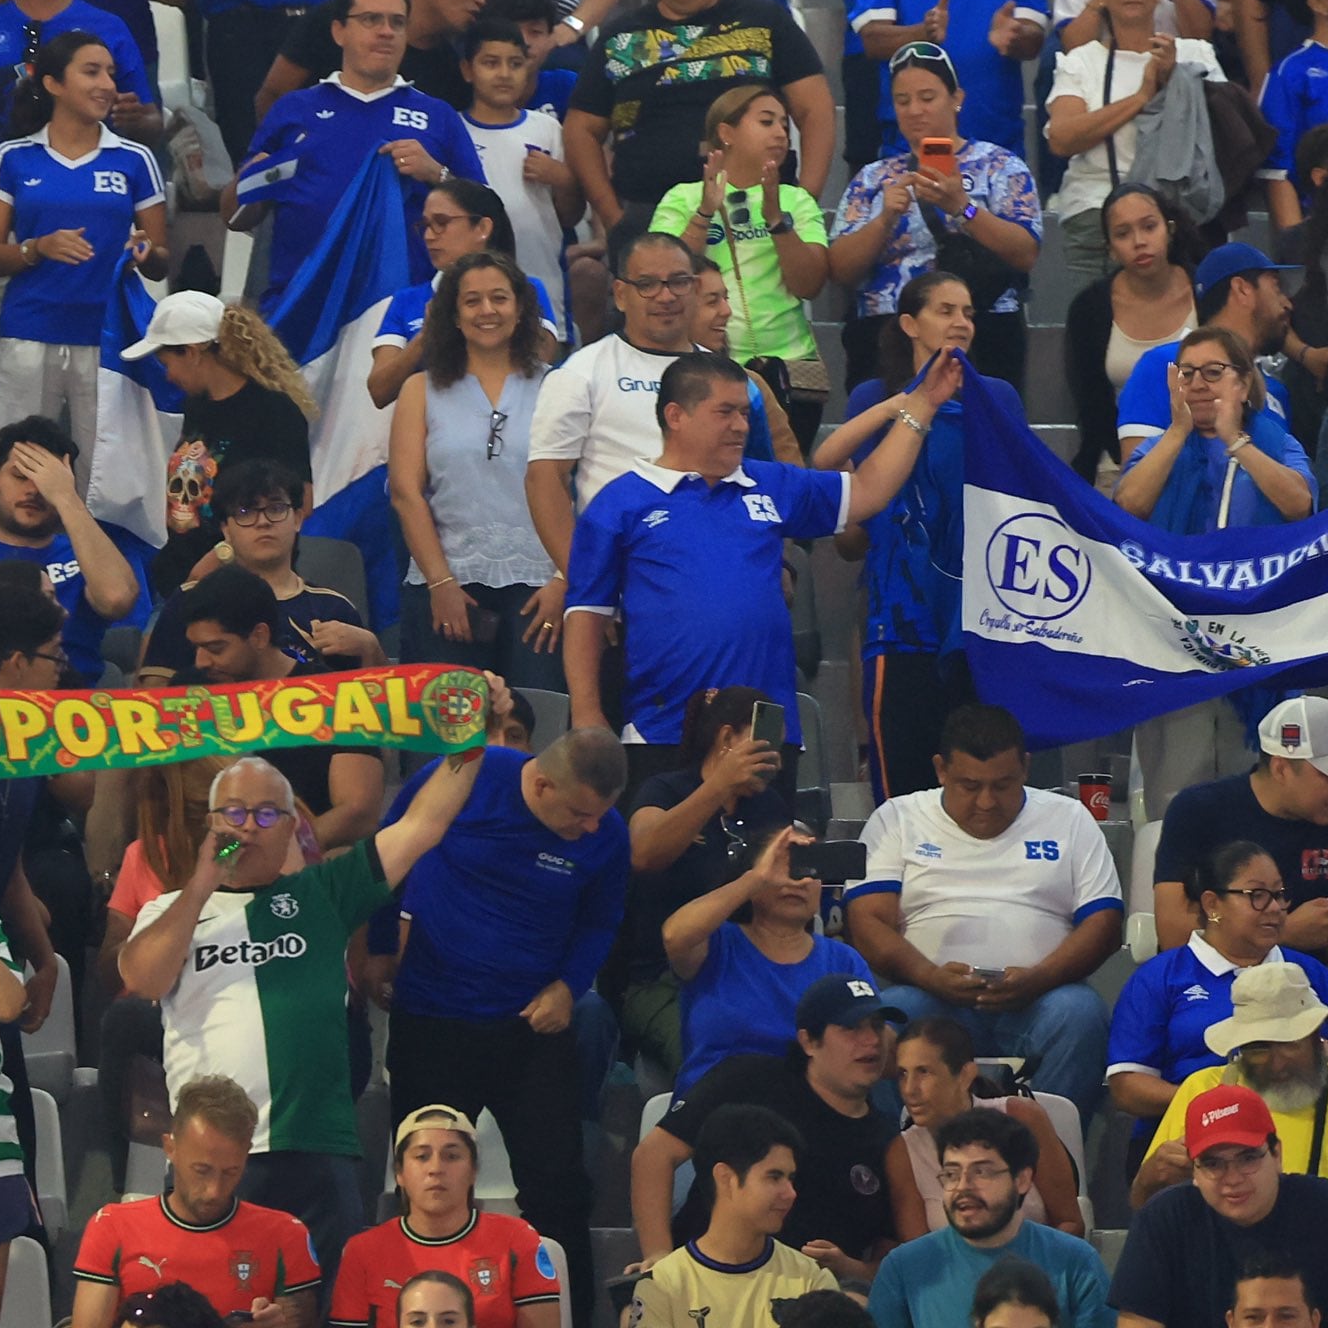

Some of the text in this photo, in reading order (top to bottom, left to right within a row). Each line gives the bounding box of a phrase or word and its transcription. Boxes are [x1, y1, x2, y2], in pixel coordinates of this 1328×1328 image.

[392, 106, 429, 131] ES
[93, 170, 127, 196] ES
[618, 377, 663, 393] Grup
[741, 493, 783, 523] ES
[45, 560, 81, 584] ES
[997, 532, 1081, 603] ES
[1208, 621, 1225, 635] EN
[1230, 630, 1246, 645] LA
[1024, 840, 1060, 861] ES
[194, 933, 308, 973] Betano
[846, 980, 875, 997] ES
